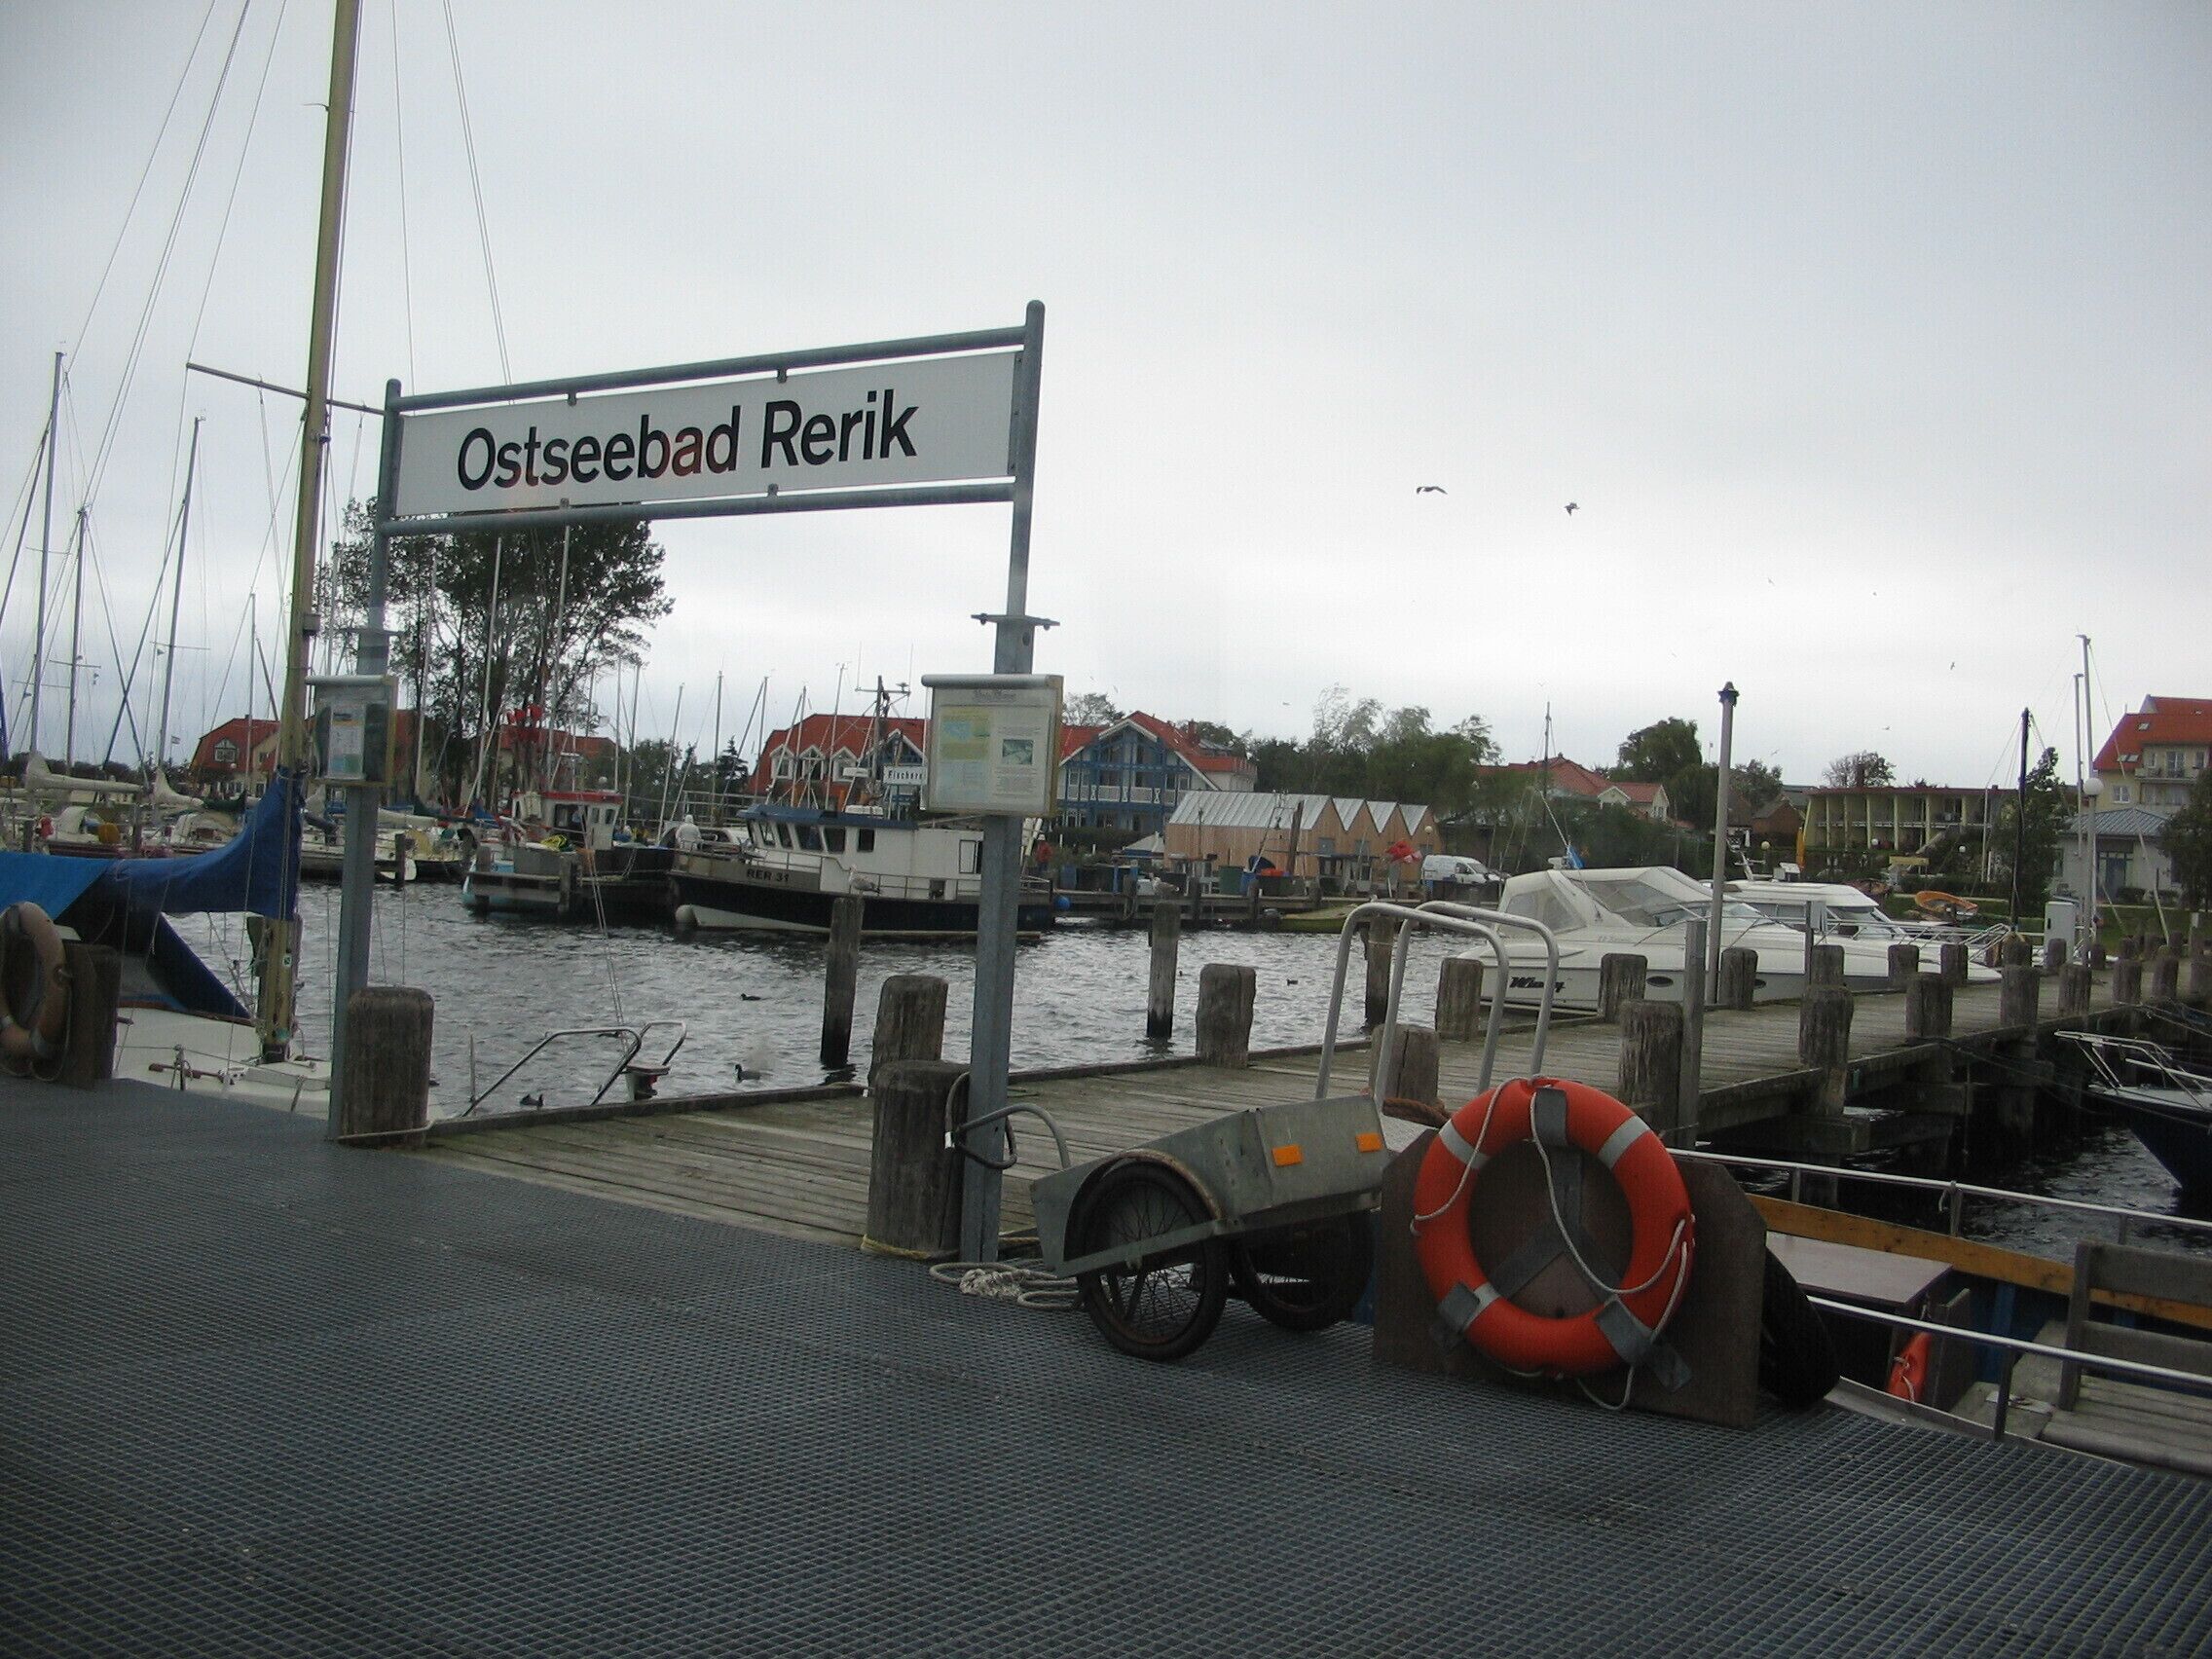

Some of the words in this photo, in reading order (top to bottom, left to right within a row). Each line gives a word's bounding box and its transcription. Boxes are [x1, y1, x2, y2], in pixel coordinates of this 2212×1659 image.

[457, 404, 742, 491] Ostseebad
[760, 387, 920, 469] Rerik
[747, 868, 772, 881] RER
[1509, 977, 1566, 993] Winy
